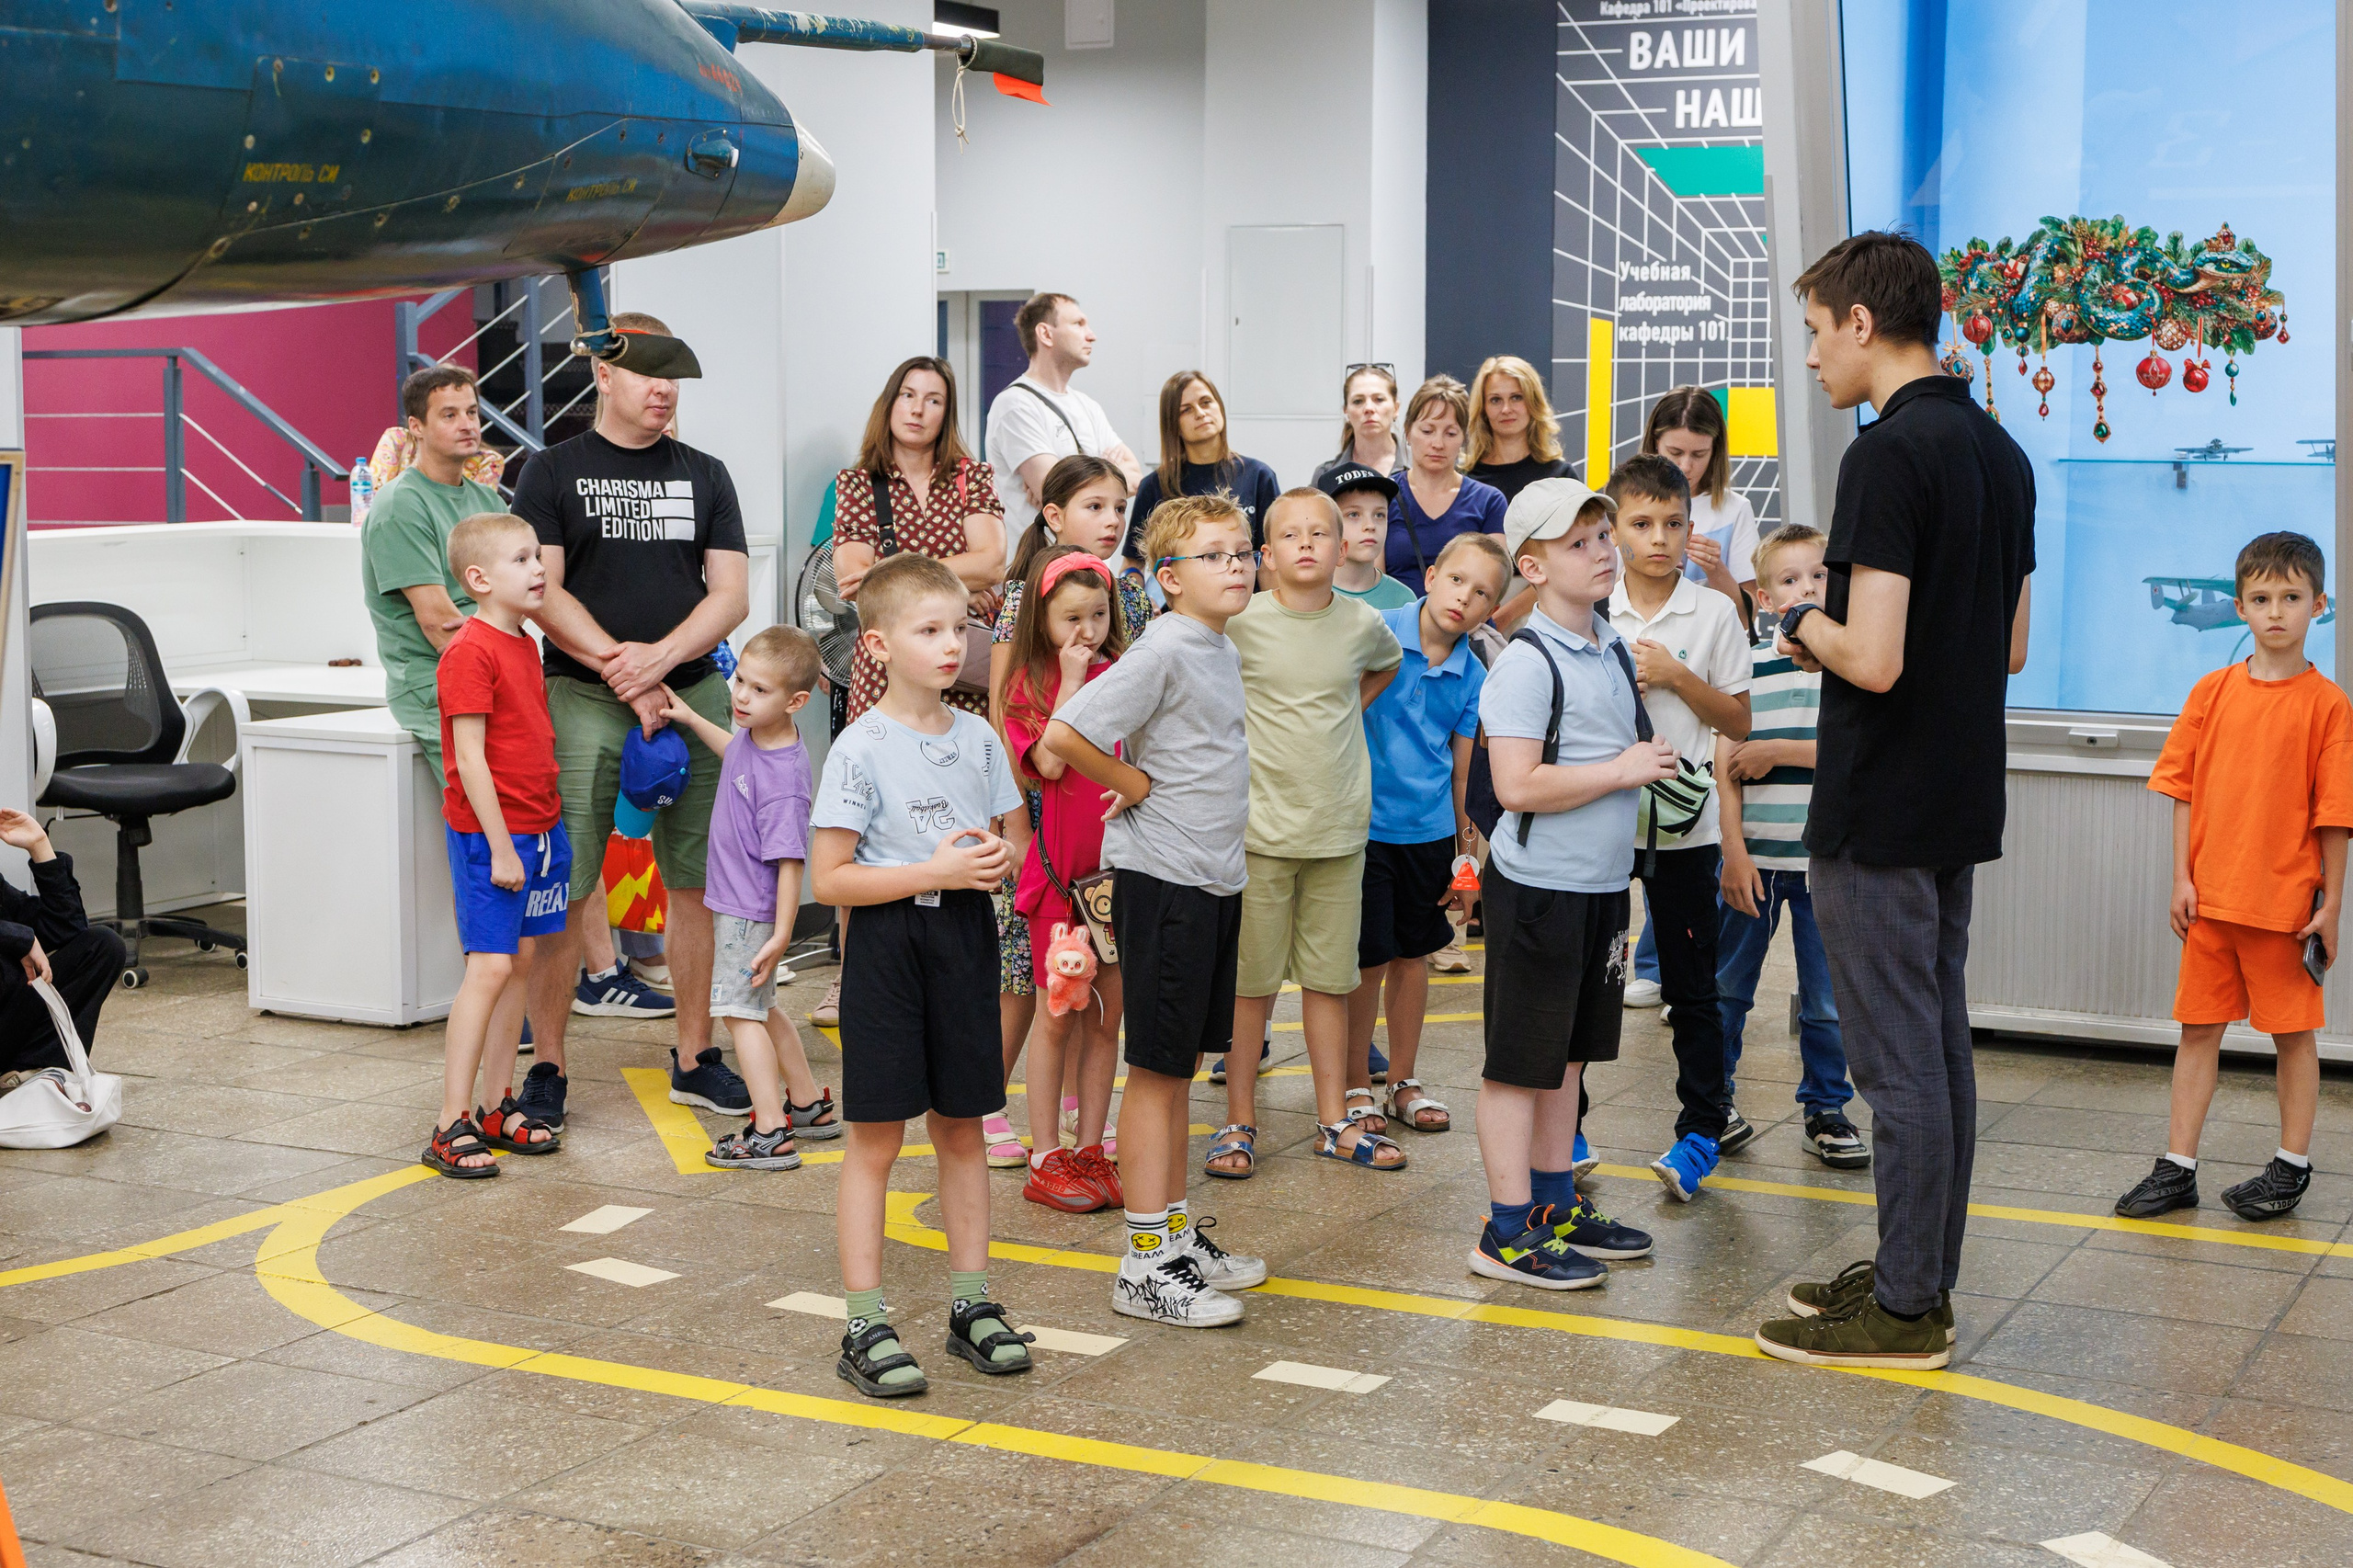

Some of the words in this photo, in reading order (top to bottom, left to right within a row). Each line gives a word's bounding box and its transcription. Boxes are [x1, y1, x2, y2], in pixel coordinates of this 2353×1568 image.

[1600, 1, 1651, 18] Кафедра
[1654, 0, 1672, 13] 101
[1629, 27, 1745, 70] ВАШИ
[1675, 87, 1763, 129] НАШ
[1620, 260, 1691, 282] Учебная
[1619, 290, 1711, 316] лаборатория
[1619, 321, 1694, 347] кафедры
[1699, 320, 1726, 341] 101
[575, 478, 665, 499] CHARISMA
[585, 496, 652, 519] LIMITED
[601, 517, 665, 541] EDITION
[1131, 1249, 1165, 1260] DREAM
